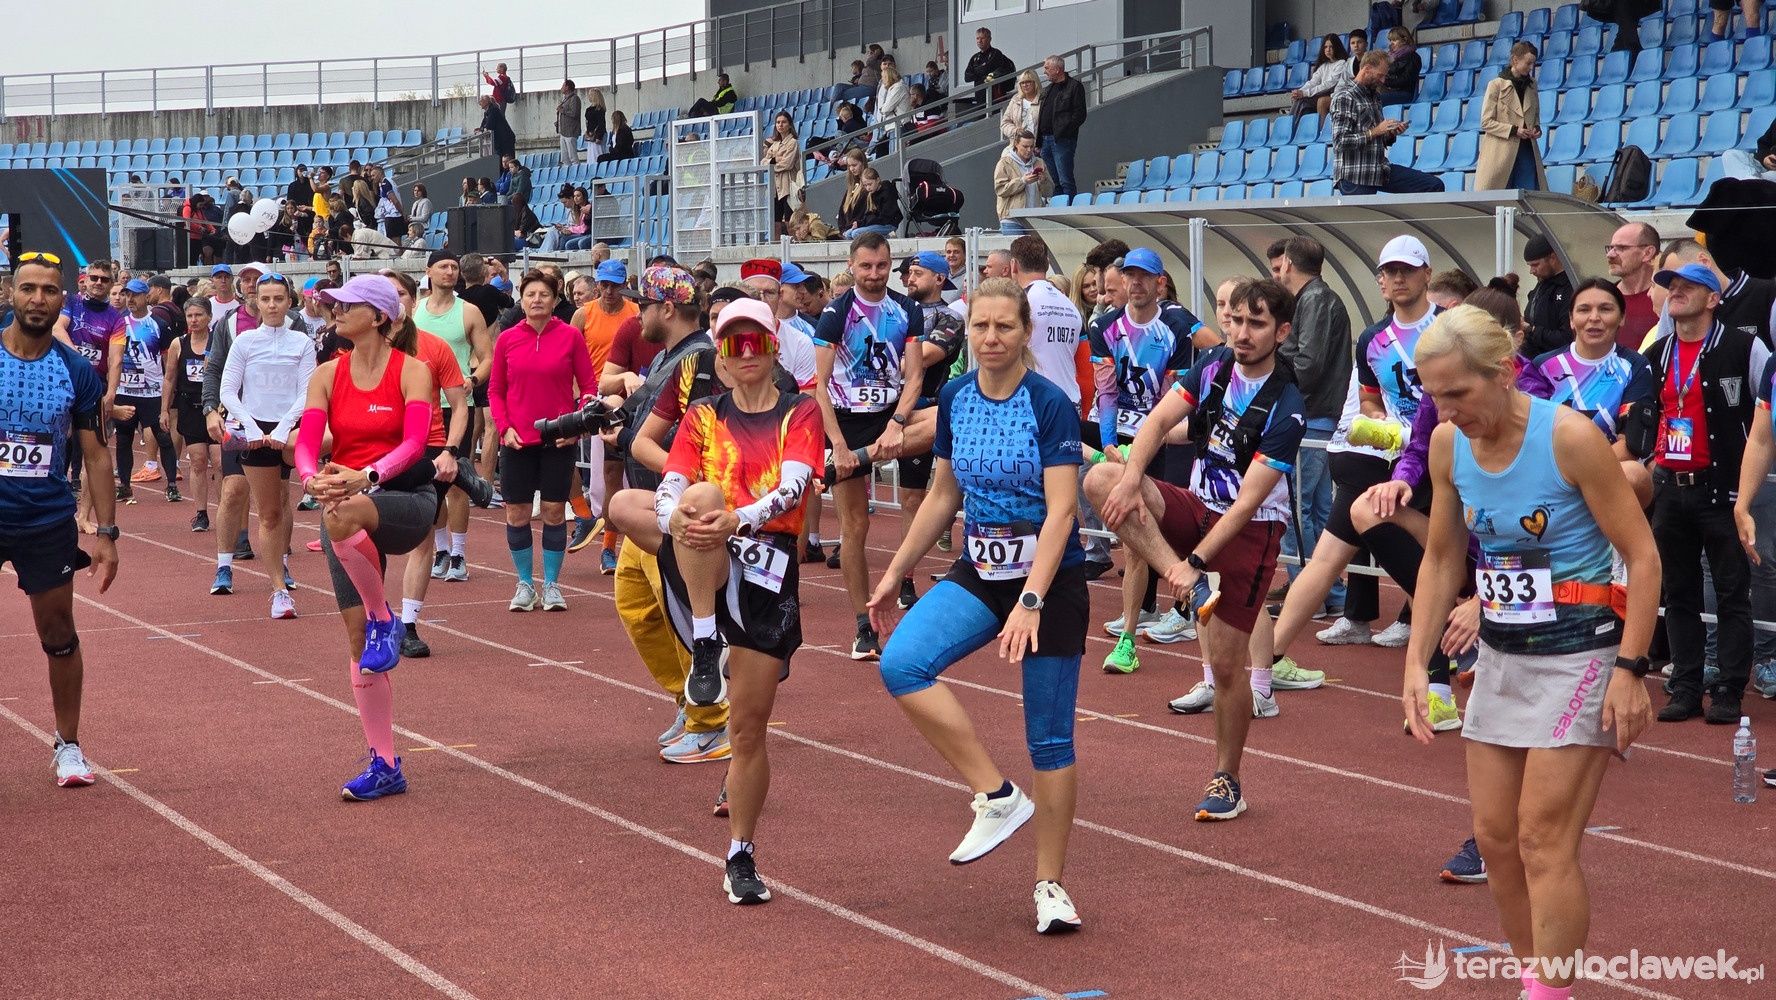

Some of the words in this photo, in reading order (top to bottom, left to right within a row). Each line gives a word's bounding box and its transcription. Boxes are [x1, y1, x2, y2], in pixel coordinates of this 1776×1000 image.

[123, 374, 141, 383] 174
[858, 388, 889, 404] 551
[0, 401, 66, 425] arkrun
[0, 443, 43, 466] 206
[1667, 434, 1691, 453] VIP
[726, 536, 776, 572] 561
[974, 539, 1024, 565] 207
[1482, 572, 1537, 603] 333
[1552, 658, 1603, 740] salomon
